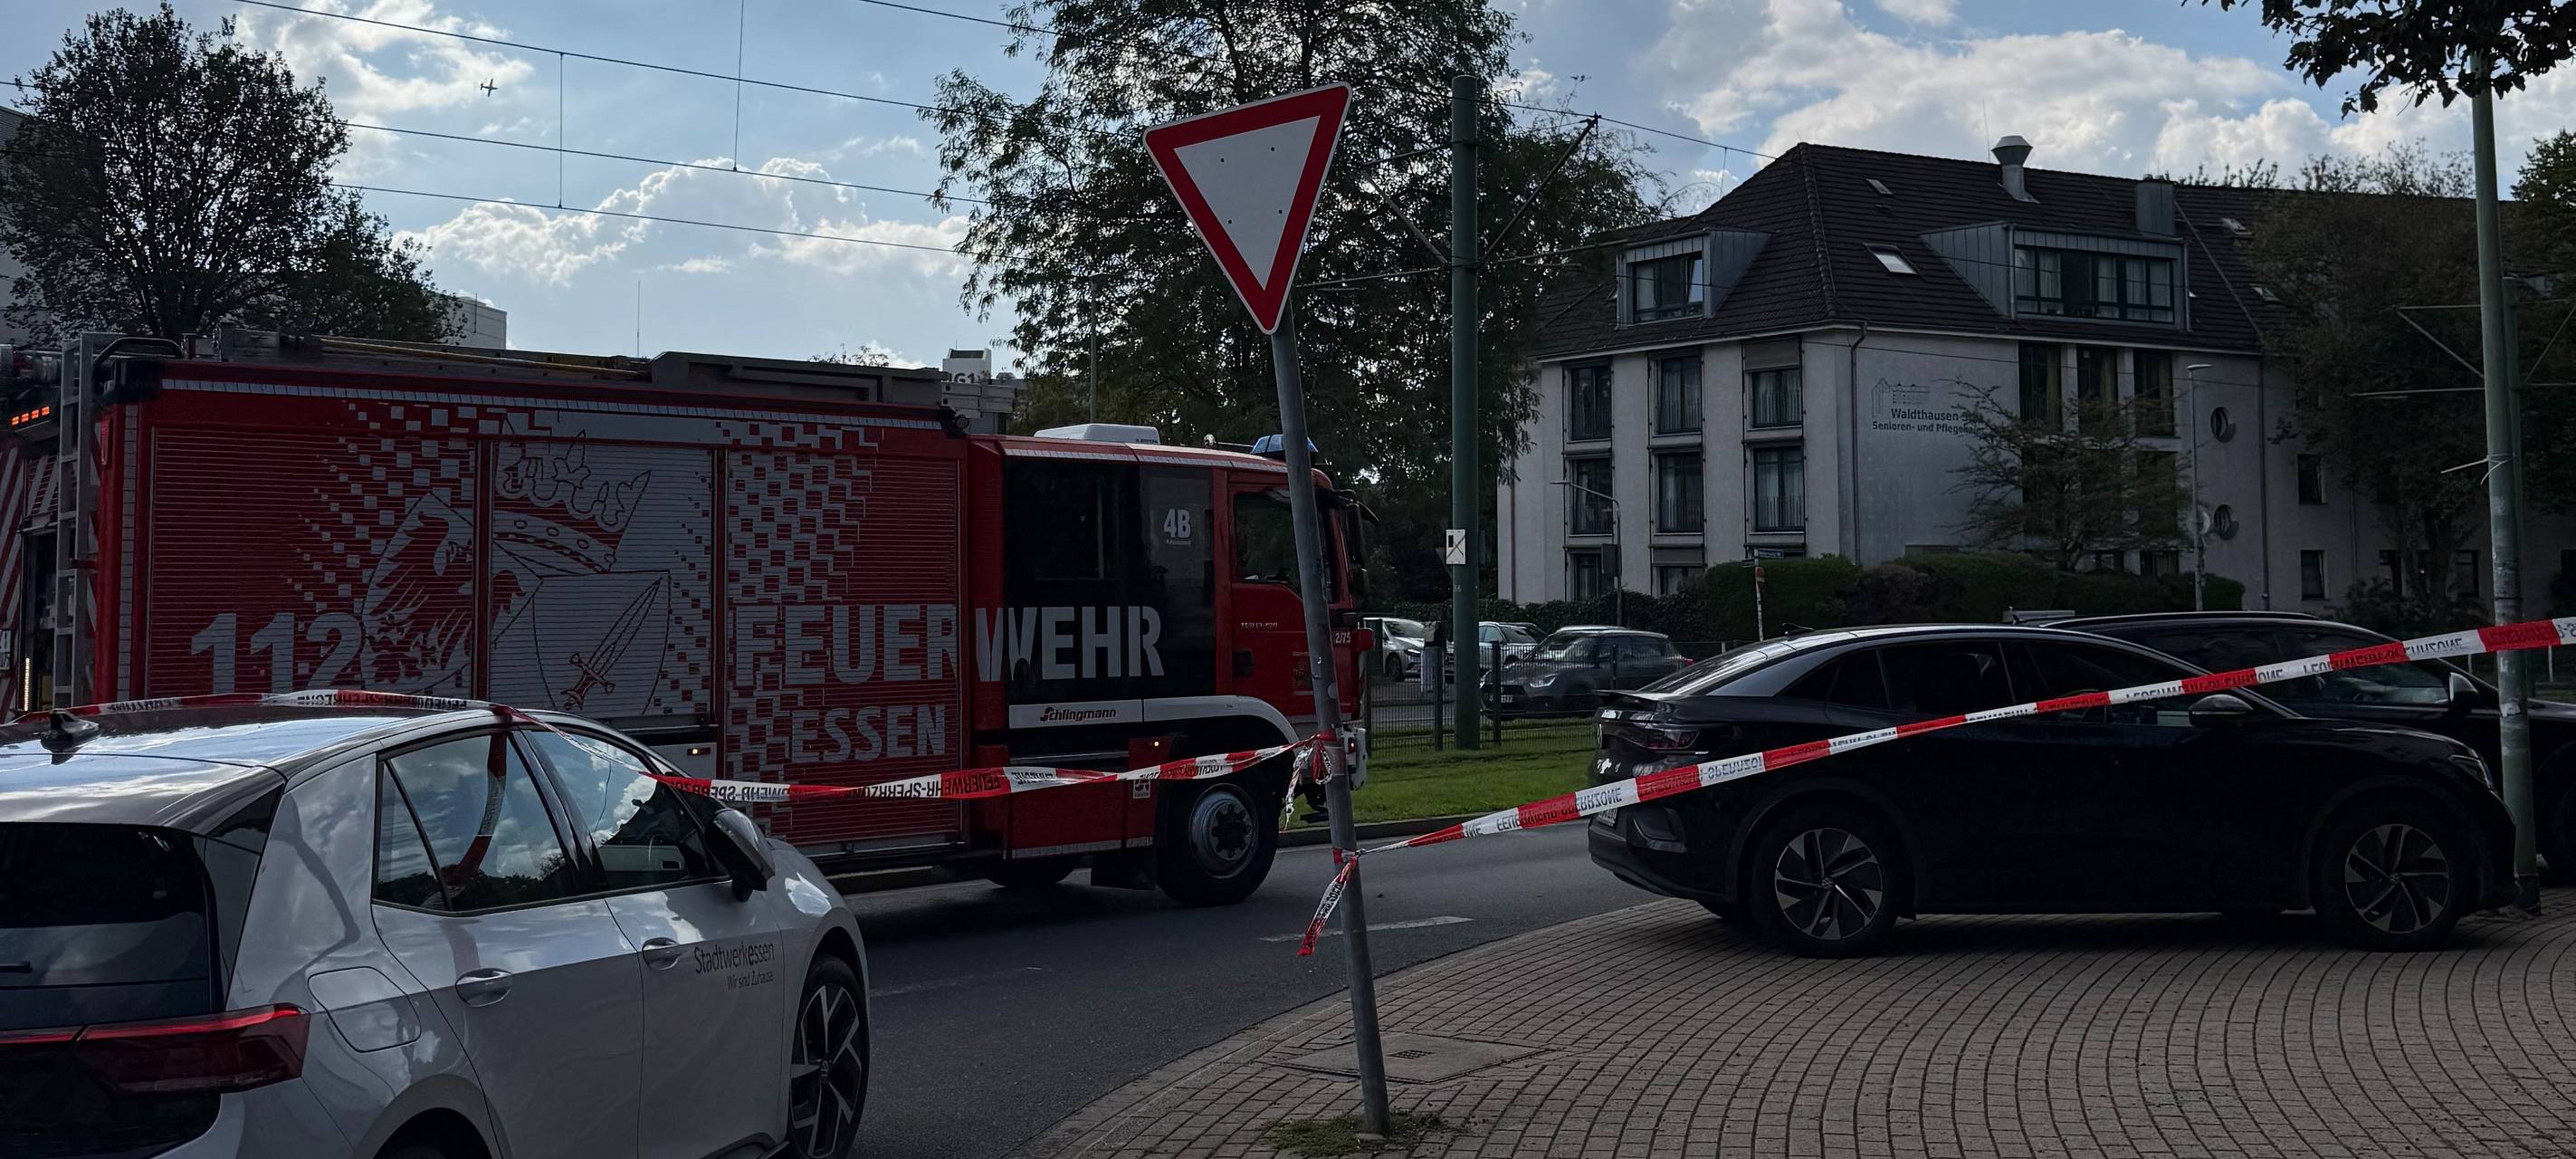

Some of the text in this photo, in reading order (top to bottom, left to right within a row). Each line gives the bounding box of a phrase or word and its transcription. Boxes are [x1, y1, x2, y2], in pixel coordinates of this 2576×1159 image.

[1873, 421, 1914, 431] Senioren-
[1917, 423, 1933, 432] und
[1891, 408, 1959, 421] Waldthausen
[1164, 508, 1191, 538] 4B
[191, 611, 364, 694] 112
[736, 604, 1166, 686] FEUERWEHR
[1040, 707, 1117, 722] Schlingmann
[791, 703, 947, 763] ESSEN
